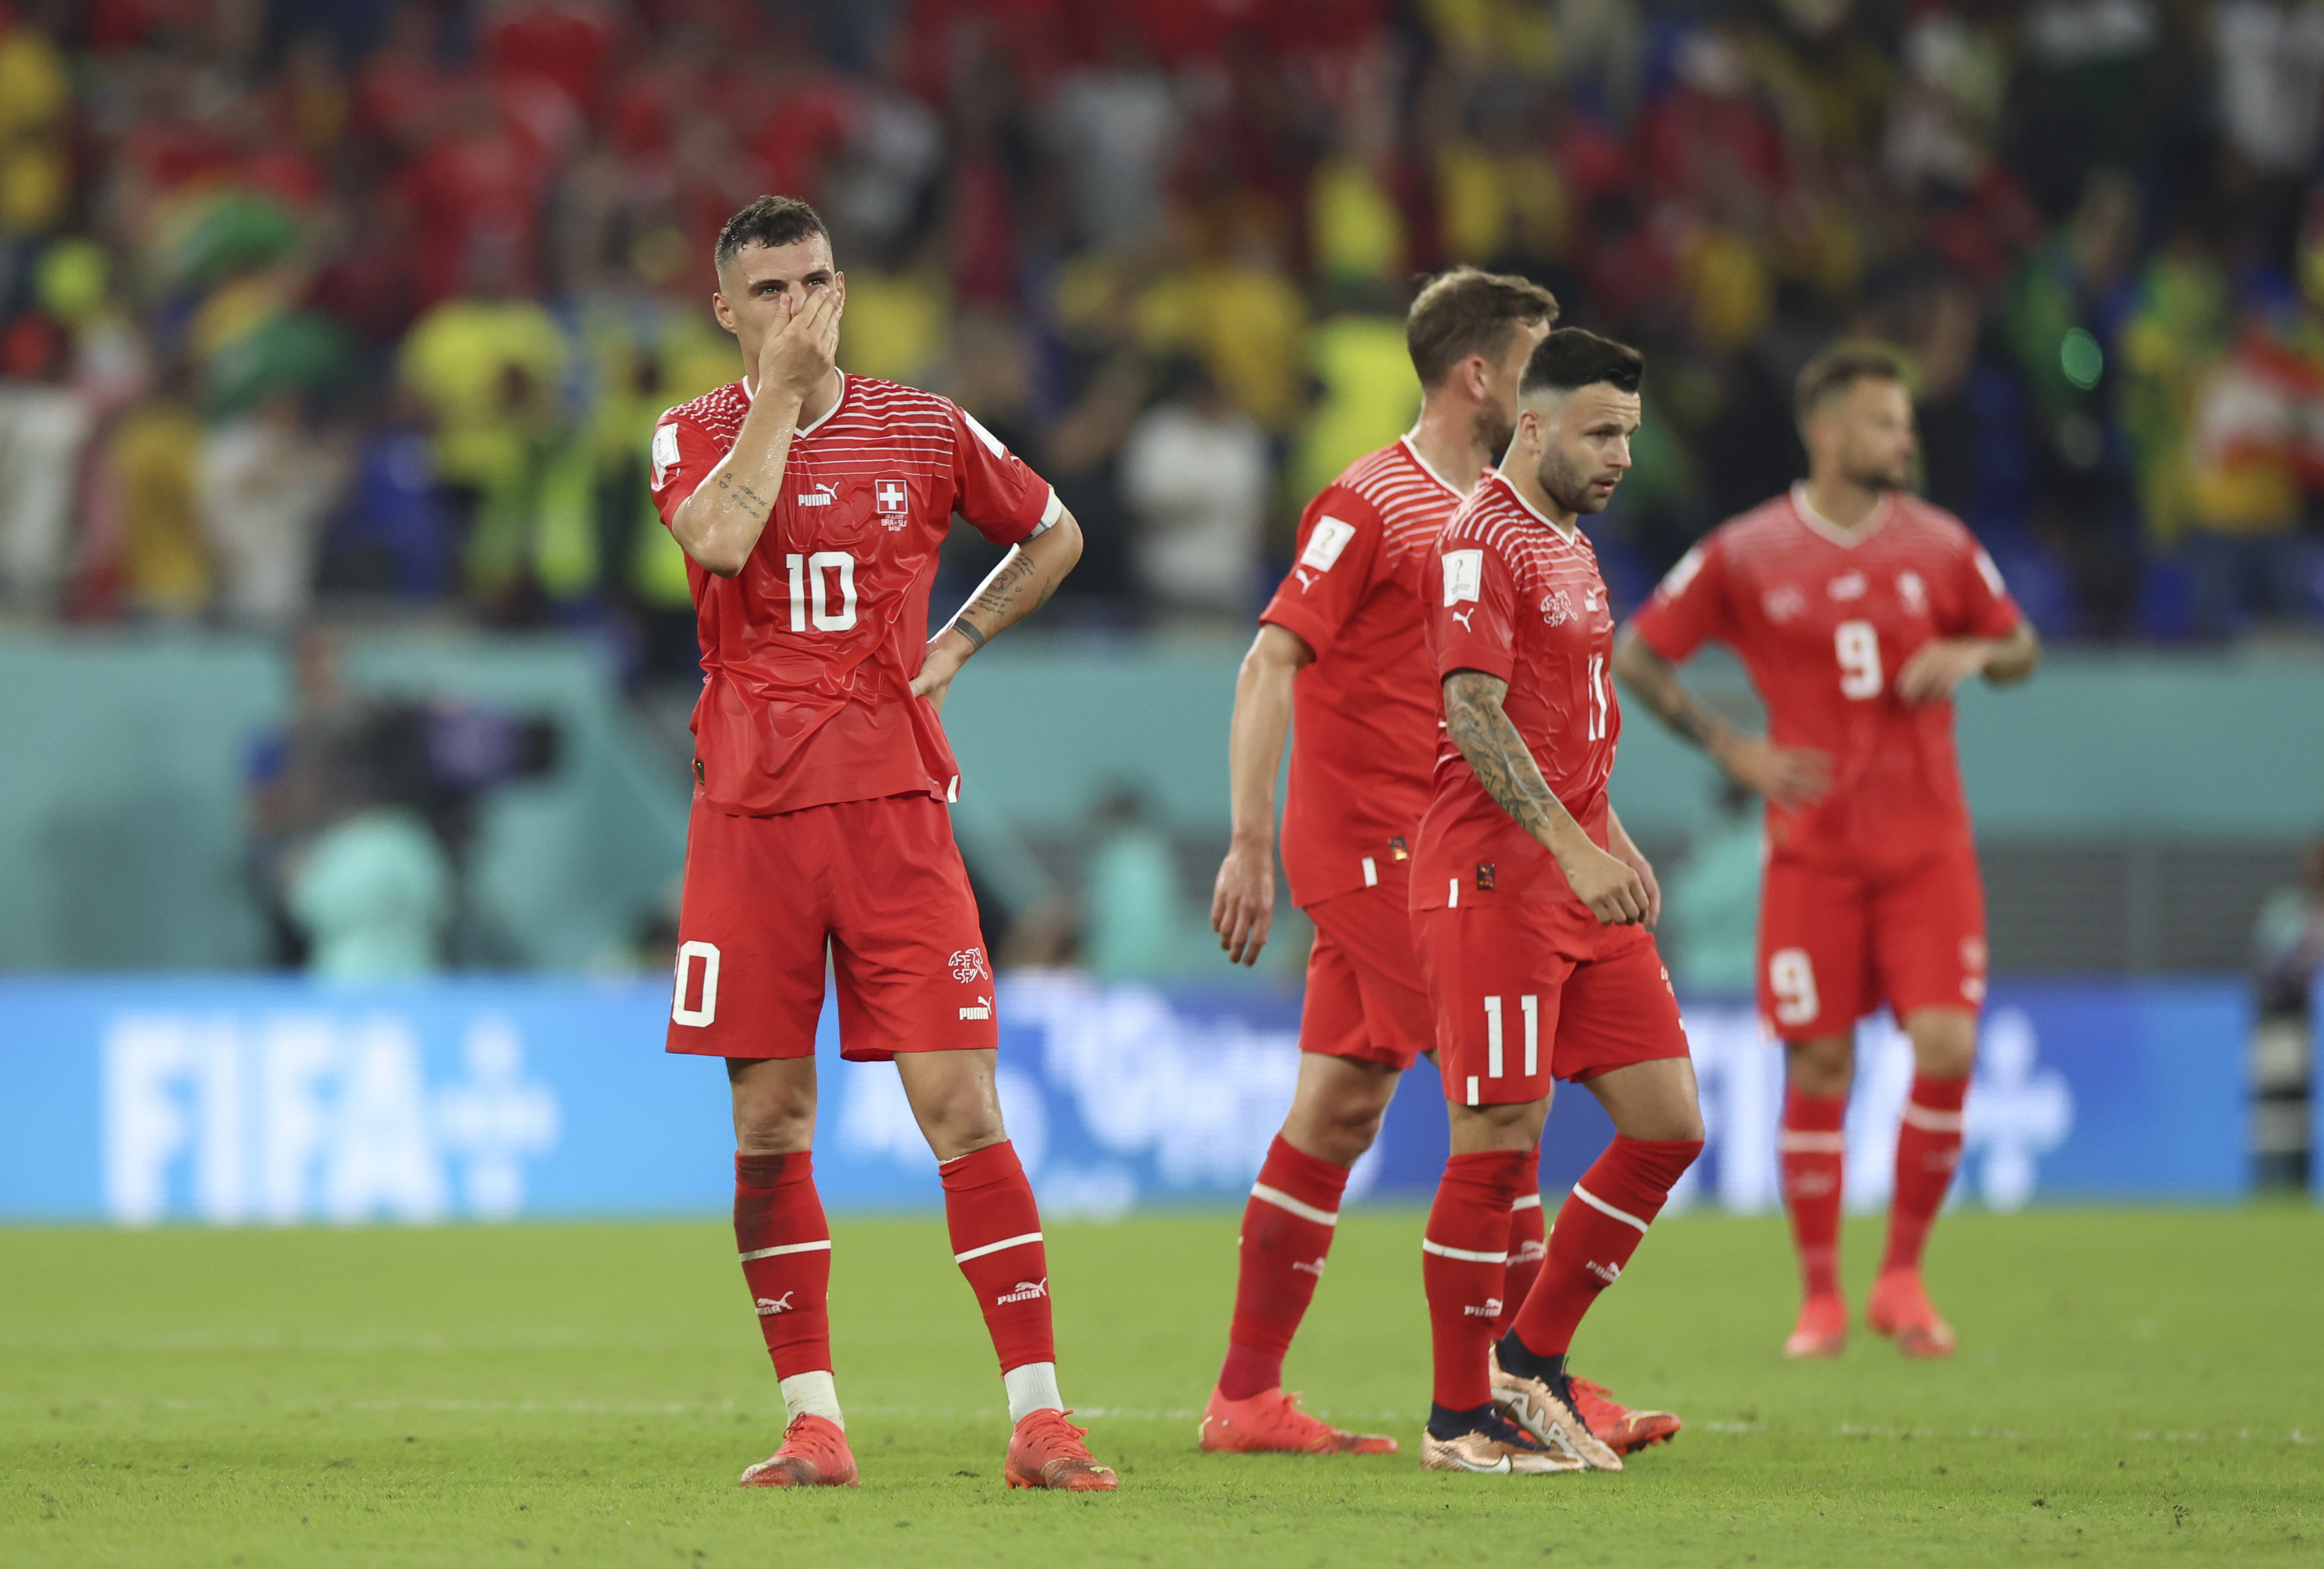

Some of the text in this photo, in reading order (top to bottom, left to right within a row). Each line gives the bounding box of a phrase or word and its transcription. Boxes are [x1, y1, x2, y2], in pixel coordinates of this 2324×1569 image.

[798, 493, 831, 506] PUMA
[786, 551, 858, 632] 10
[1834, 619, 1884, 701] 9
[670, 940, 721, 1028] 0
[959, 1007, 989, 1020] PUMA
[1769, 946, 1821, 1026] 9
[1484, 994, 1537, 1078] 11
[997, 1289, 1041, 1305] PUMA
